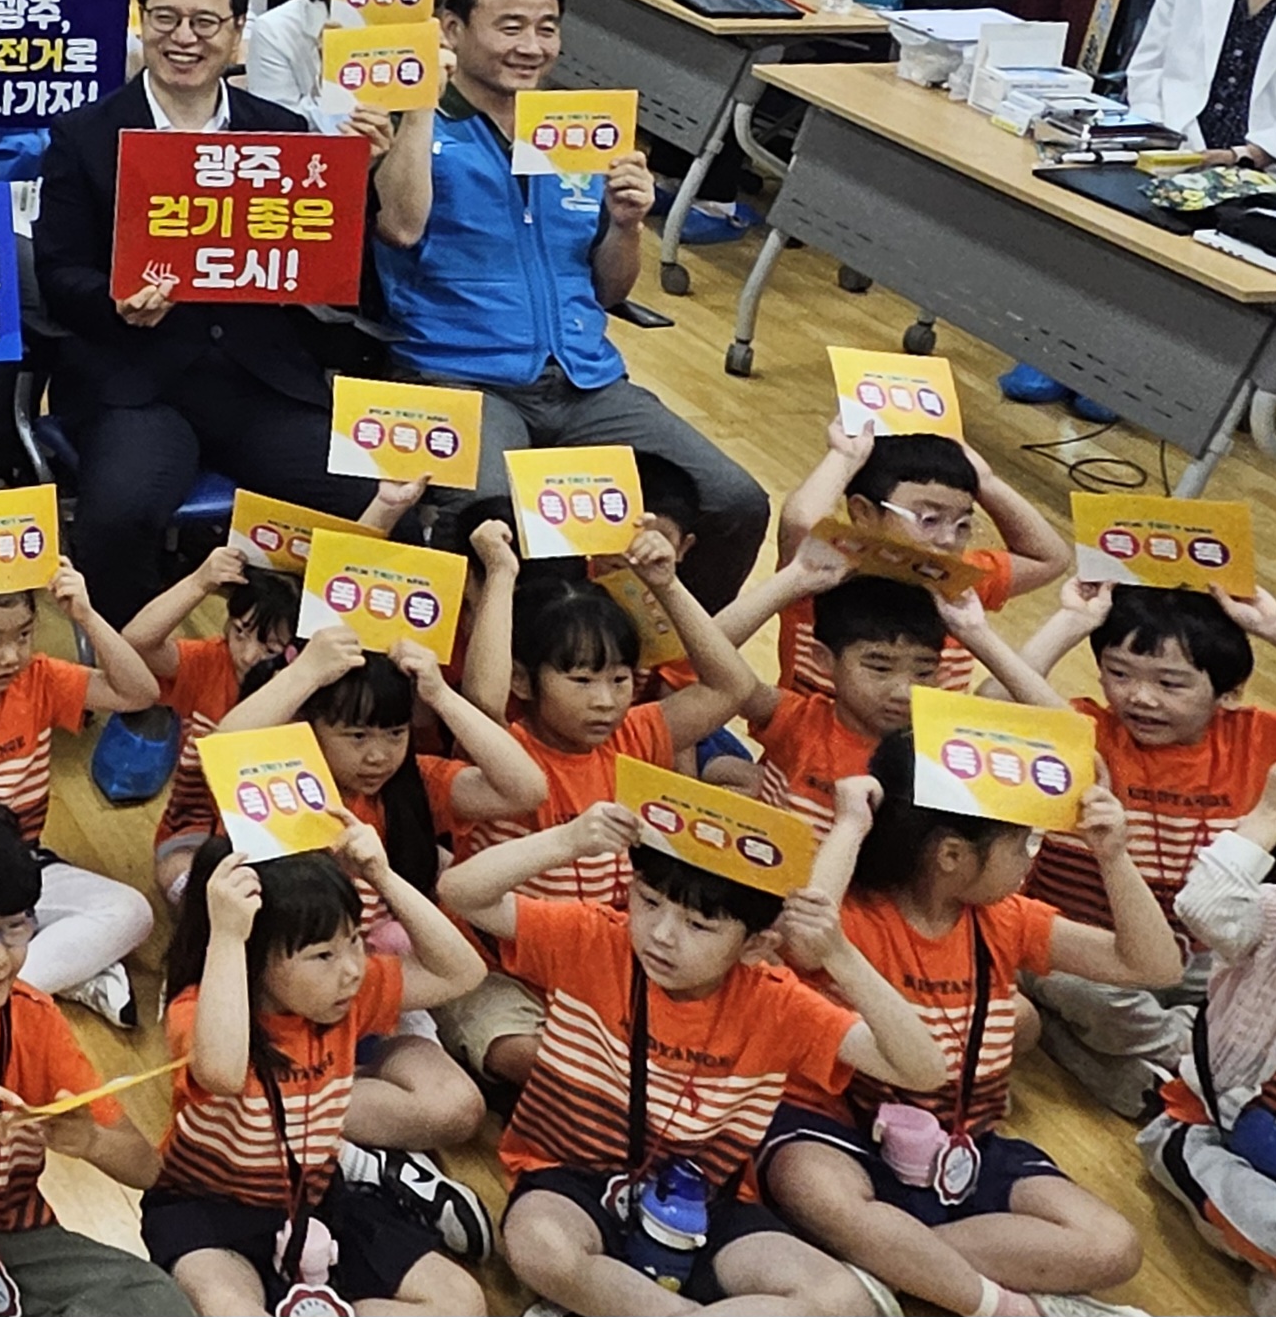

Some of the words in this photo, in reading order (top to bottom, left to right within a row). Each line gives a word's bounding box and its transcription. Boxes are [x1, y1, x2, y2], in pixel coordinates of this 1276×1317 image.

[193, 145, 293, 194] 광주,
[148, 195, 233, 240] 걷기
[247, 198, 335, 241] 좋은
[192, 247, 299, 292] 도시!
